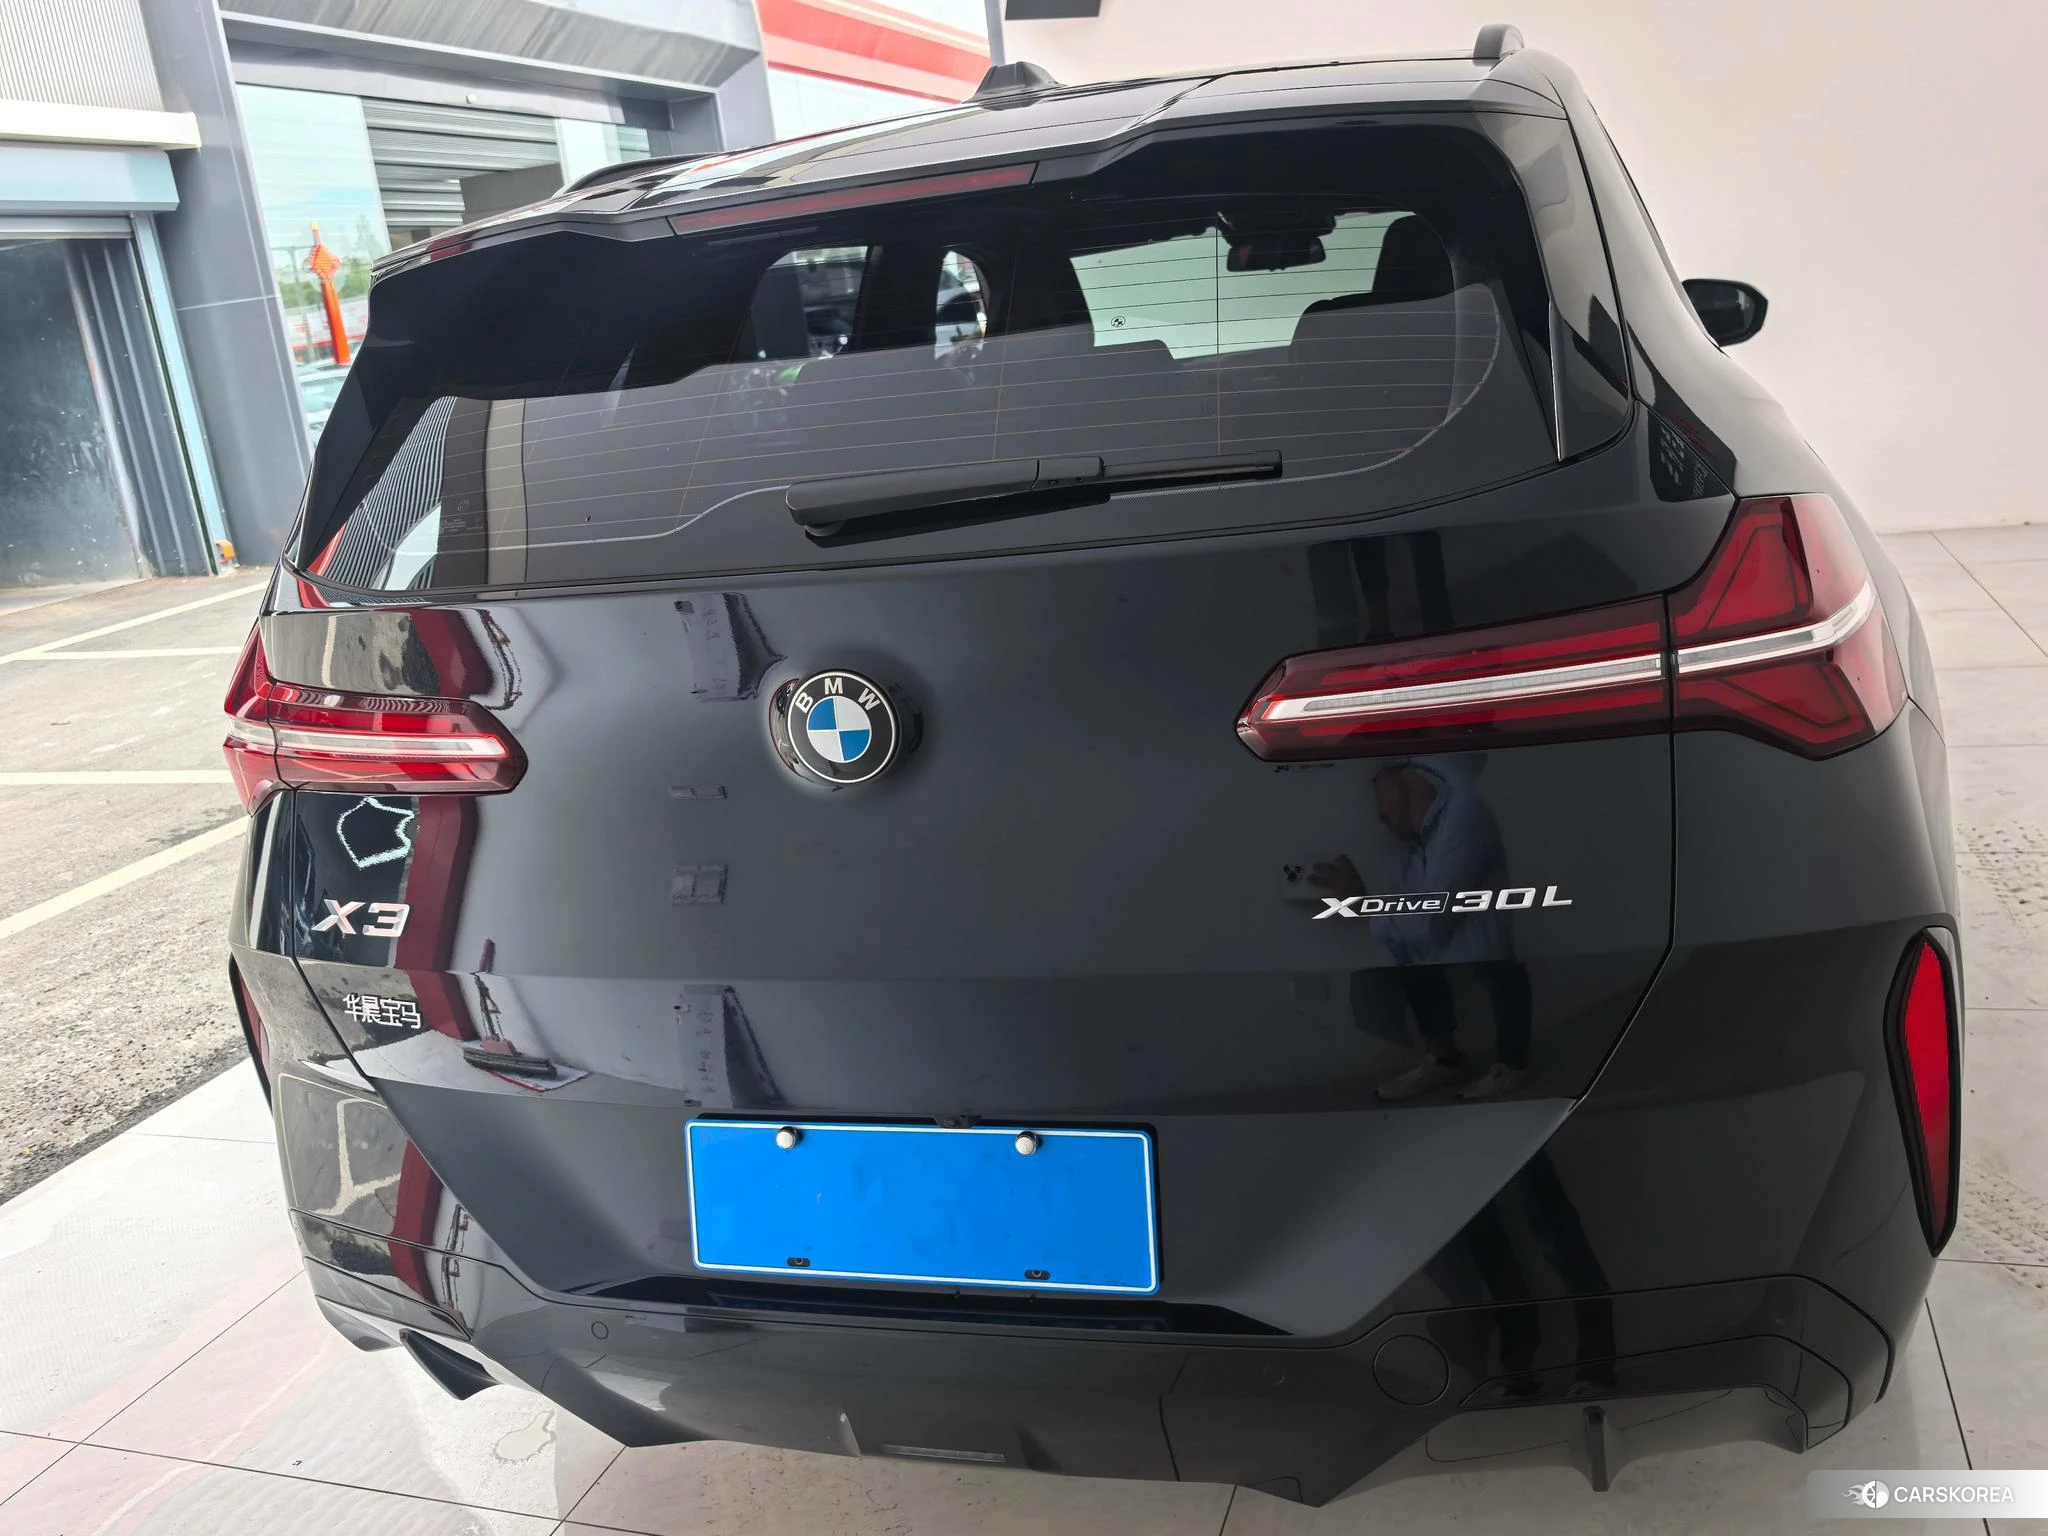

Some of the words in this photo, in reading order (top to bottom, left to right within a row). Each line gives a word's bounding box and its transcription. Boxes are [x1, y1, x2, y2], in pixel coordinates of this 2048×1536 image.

[795, 677, 881, 713] BMW
[311, 898, 410, 937] X3
[342, 994, 421, 1029] 华晨宝马
